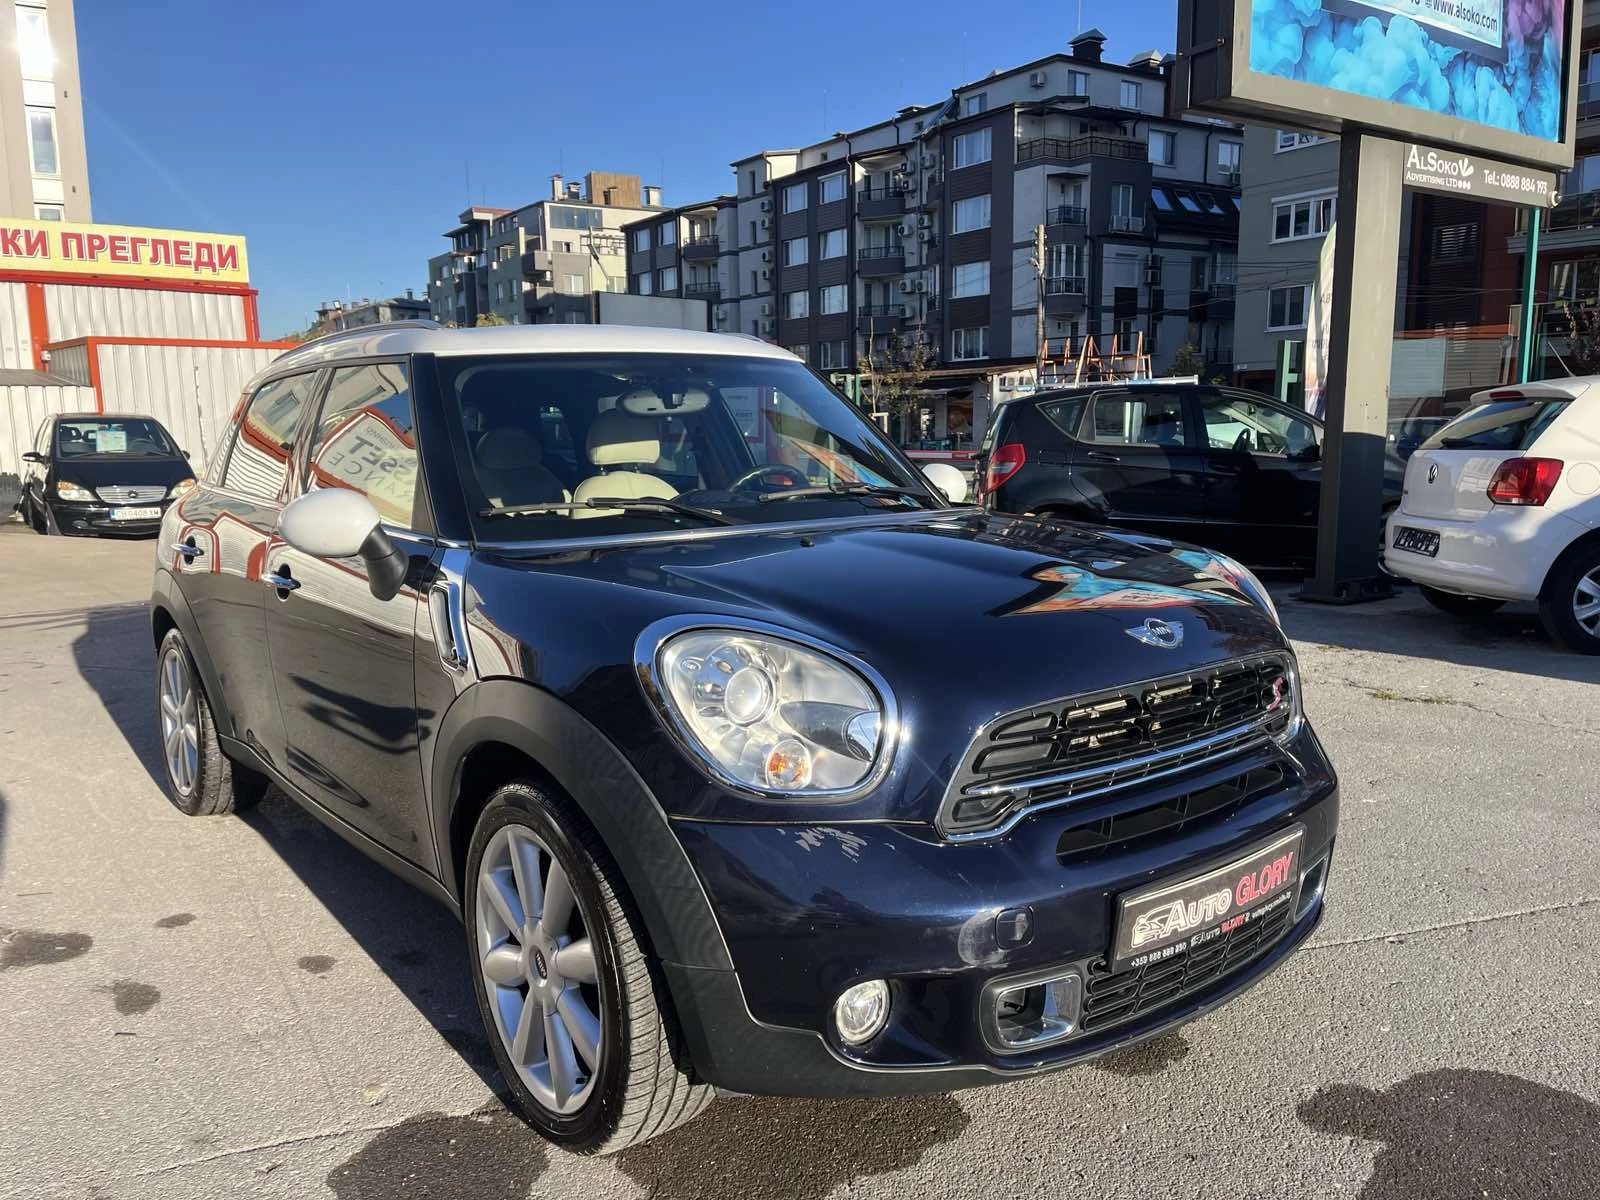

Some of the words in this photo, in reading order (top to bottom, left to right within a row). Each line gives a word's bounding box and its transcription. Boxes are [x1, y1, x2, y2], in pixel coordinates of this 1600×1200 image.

[1432, 0, 1498, 32] www.alsoko.com
[1500, 173, 1520, 190] 0888
[1520, 176, 1536, 192] 884
[1536, 179, 1548, 195] 193
[0, 228, 49, 258] КИ
[60, 231, 239, 273] ПРЕГЛЕДИ
[1161, 888, 1232, 937] AUTO
[1235, 852, 1294, 906] GLORY
